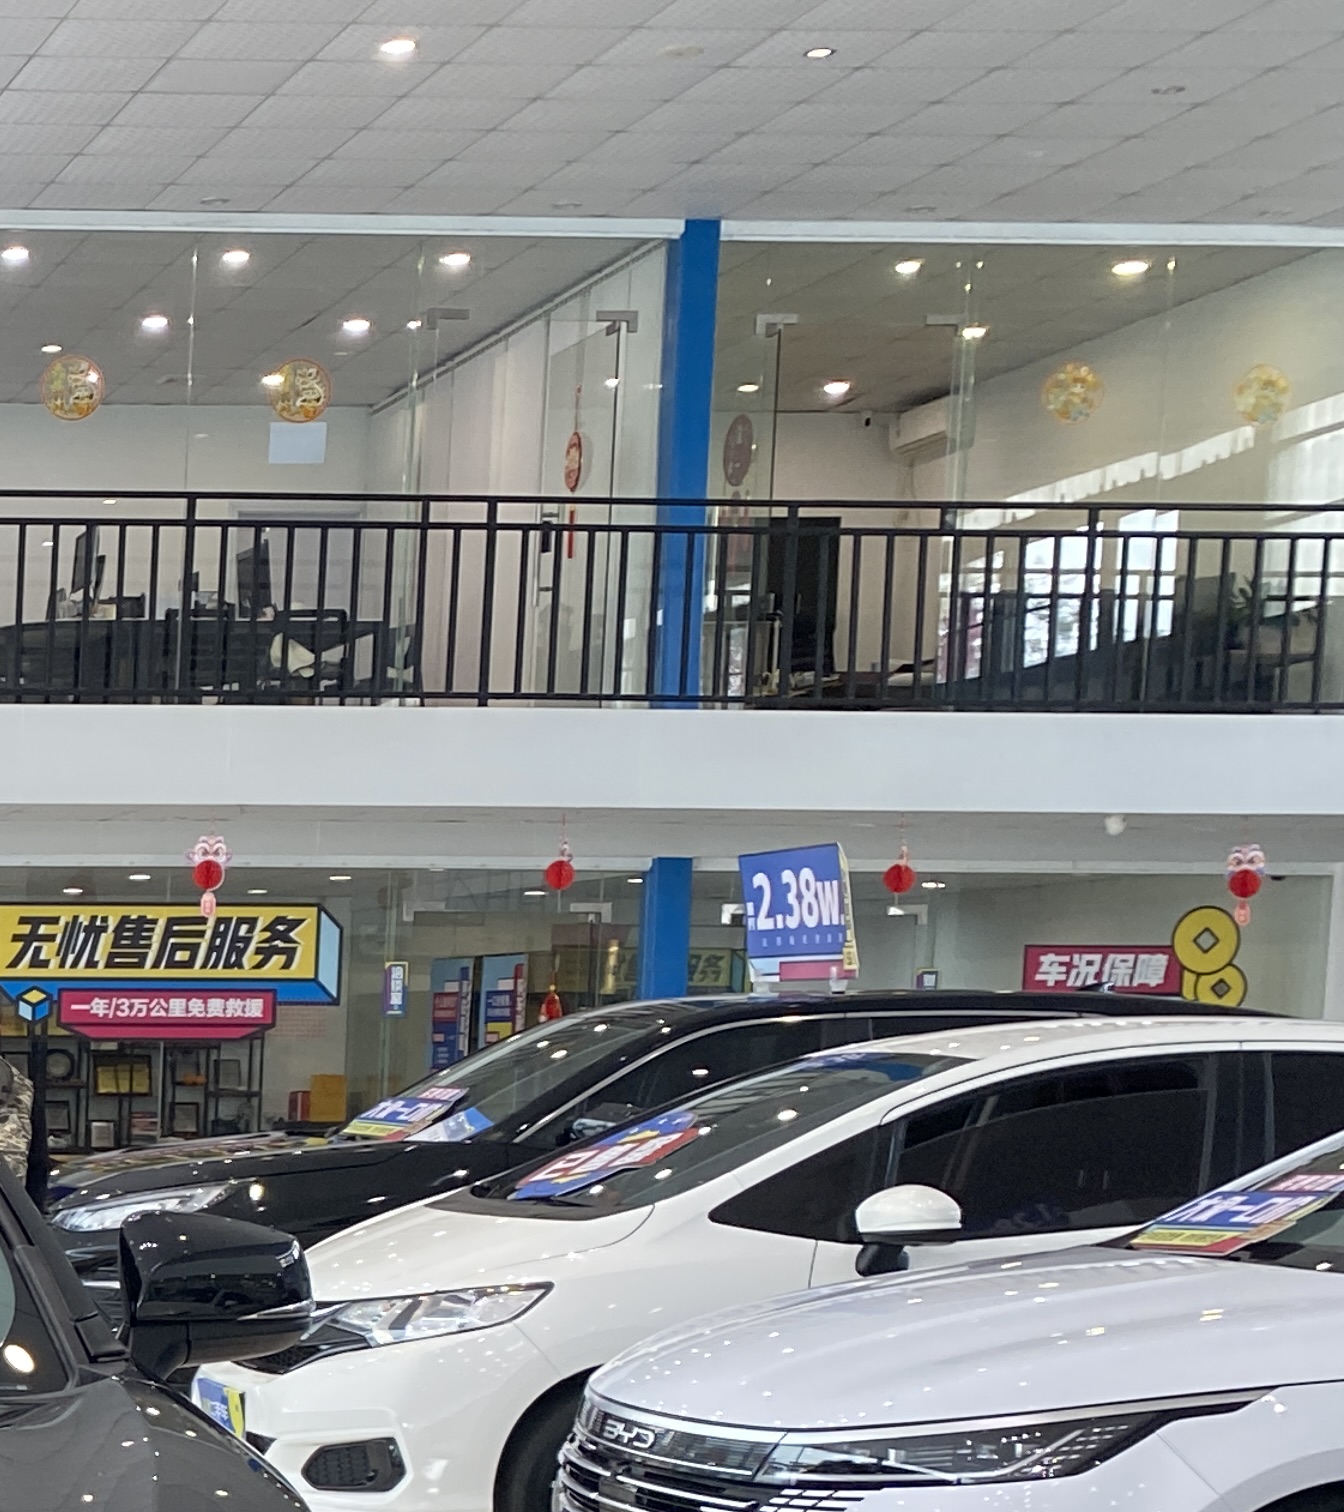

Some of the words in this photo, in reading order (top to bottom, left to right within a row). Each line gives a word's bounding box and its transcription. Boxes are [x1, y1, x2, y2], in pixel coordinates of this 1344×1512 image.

[7, 914, 308, 970] 无忧售后服务
[1035, 953, 1169, 987] 车况保障
[70, 997, 264, 1019] 一年/3万公里免费救援
[602, 1419, 656, 1448] BYD
